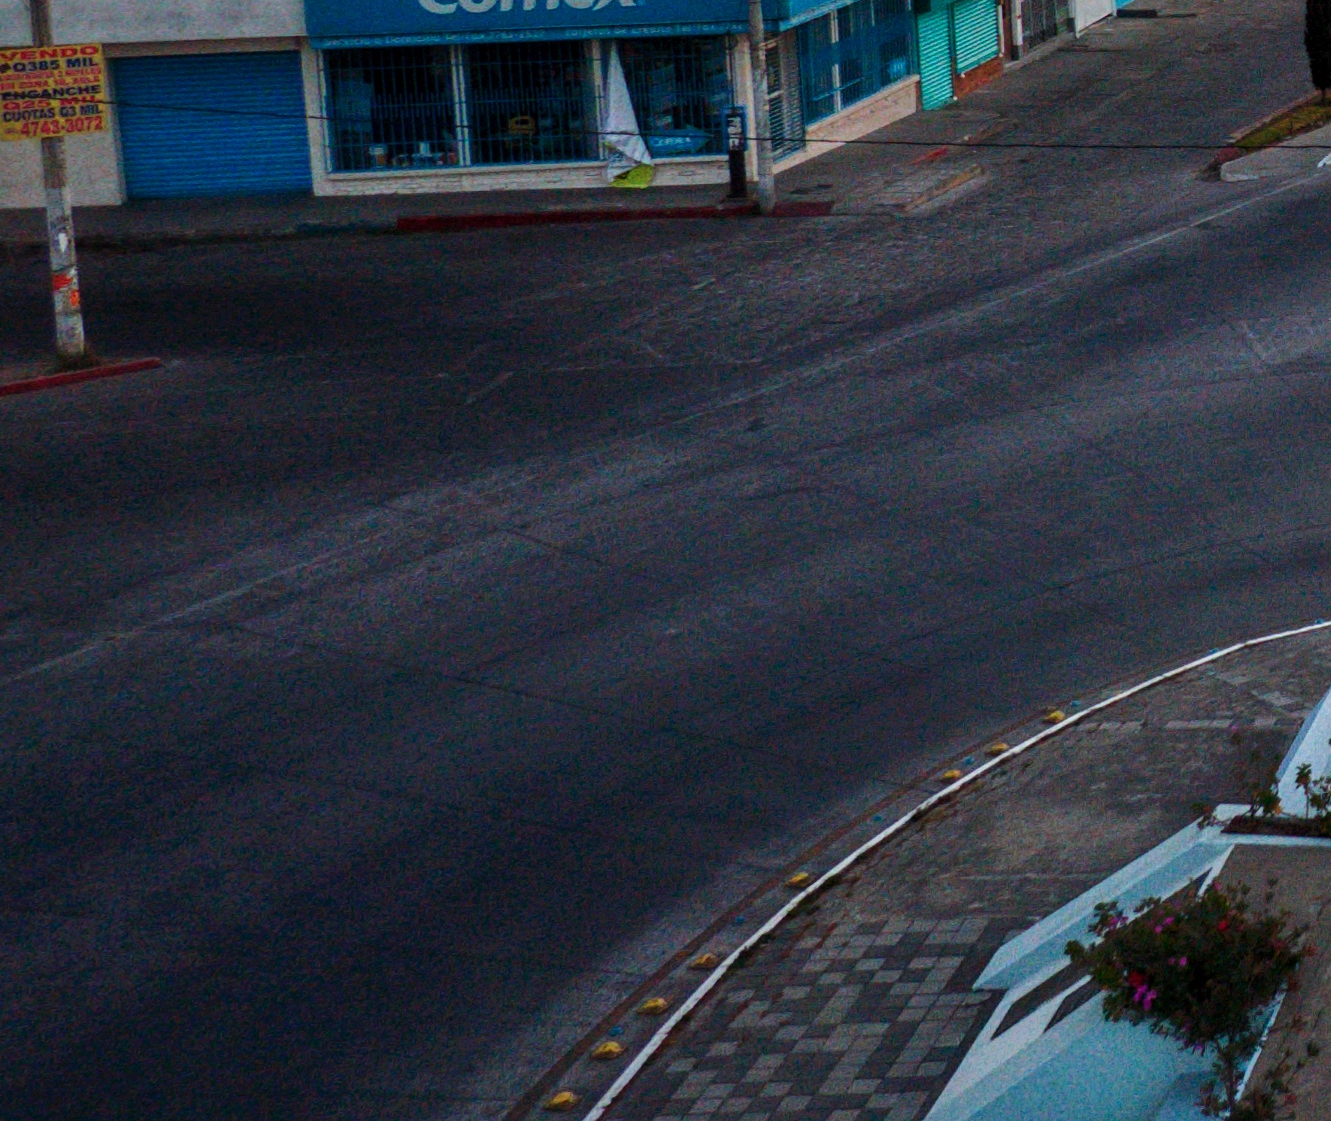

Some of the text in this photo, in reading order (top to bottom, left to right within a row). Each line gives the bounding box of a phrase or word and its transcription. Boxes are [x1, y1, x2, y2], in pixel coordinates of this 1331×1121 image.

[0, 45, 99, 61] VENDO
[12, 57, 99, 73] Q385 MIL
[2, 84, 101, 100] ENGANCHE
[3, 98, 51, 111] Q25
[3, 104, 101, 122] CUOTAS Q3 MIL
